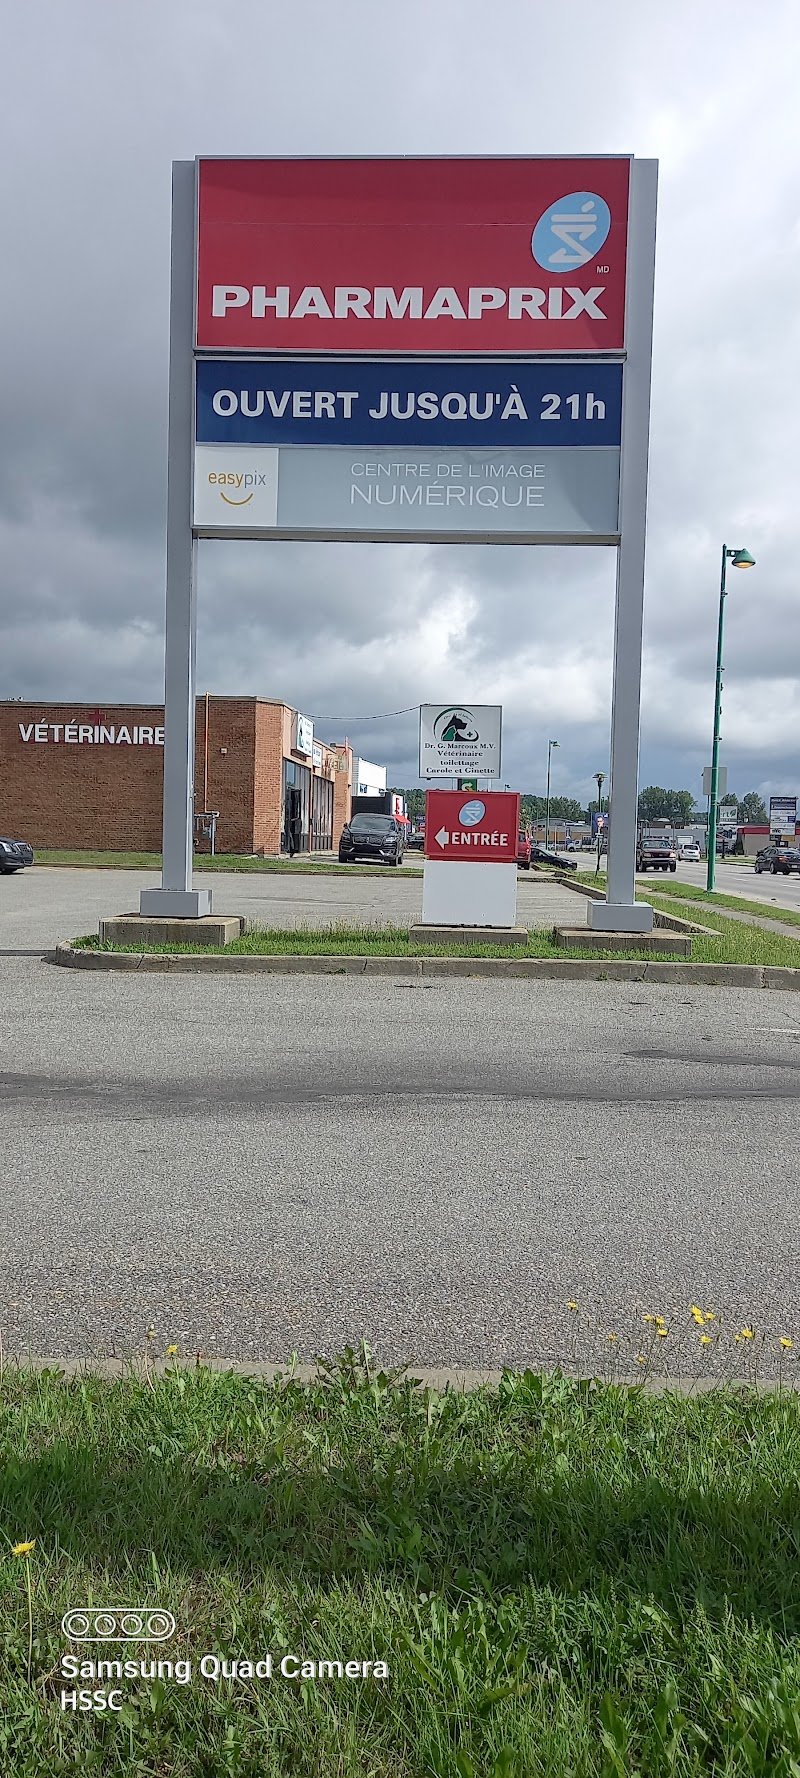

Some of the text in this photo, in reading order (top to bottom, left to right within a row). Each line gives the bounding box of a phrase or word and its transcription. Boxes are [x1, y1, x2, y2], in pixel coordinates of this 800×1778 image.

[596, 265, 610, 273] MD
[211, 285, 608, 320] PHARMAPRIX
[212, 385, 606, 420] OUVERT JUSQU'À 21h
[208, 470, 267, 488] easypix
[351, 463, 546, 478] CENTRE DE L'IMAGE
[350, 480, 545, 508] NUMÉRIQUE
[18, 718, 165, 745] VÉTÉRINAIRE
[451, 830, 508, 847] ENTRÉE
